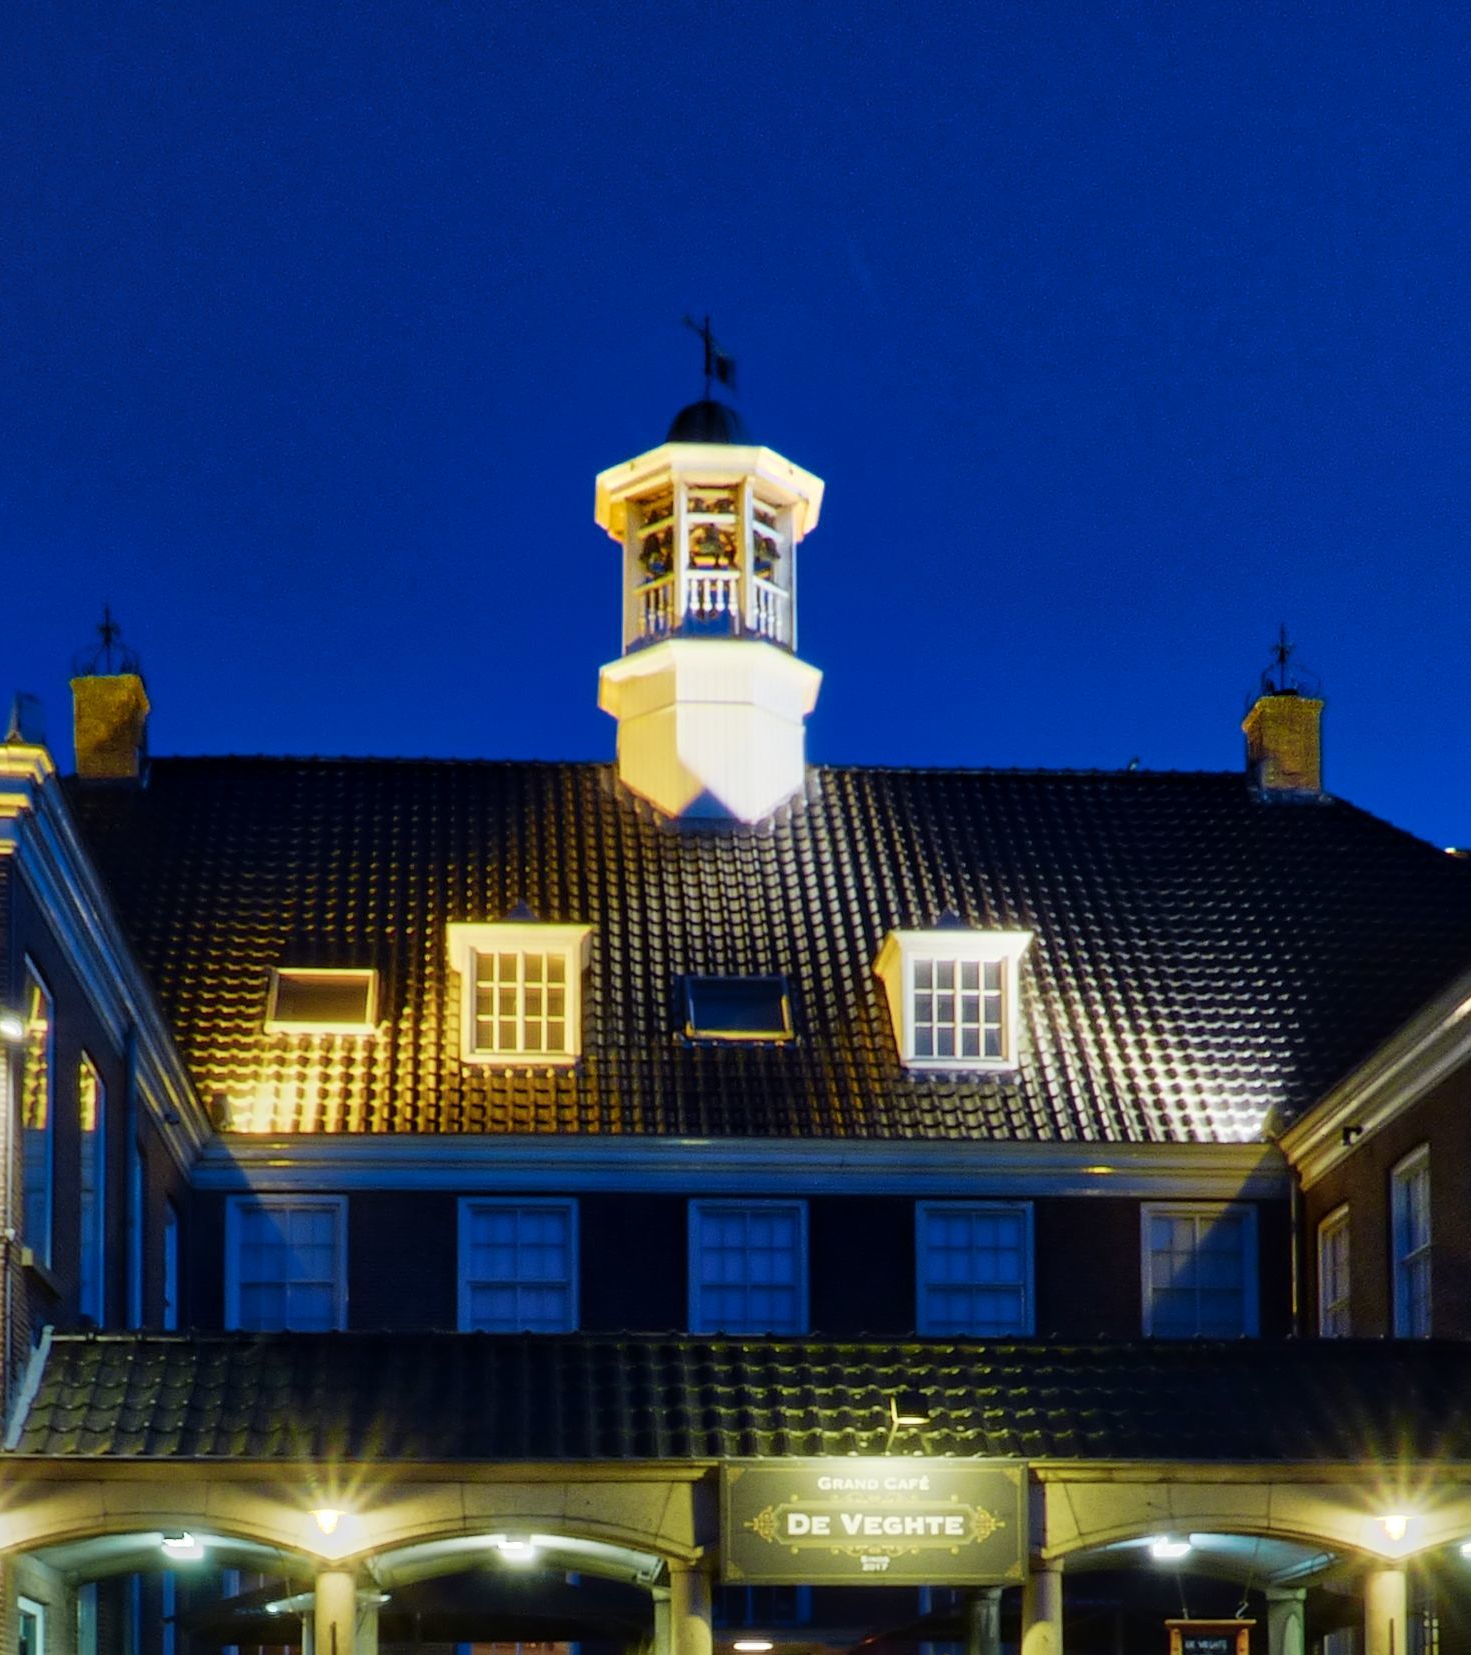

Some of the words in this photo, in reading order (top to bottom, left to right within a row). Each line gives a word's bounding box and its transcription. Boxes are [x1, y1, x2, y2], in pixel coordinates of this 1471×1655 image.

[817, 1476, 878, 1491] GRAND
[884, 1475, 930, 1491] CAFÉ
[787, 1513, 831, 1535] DE
[840, 1513, 964, 1536] VEGHTE
